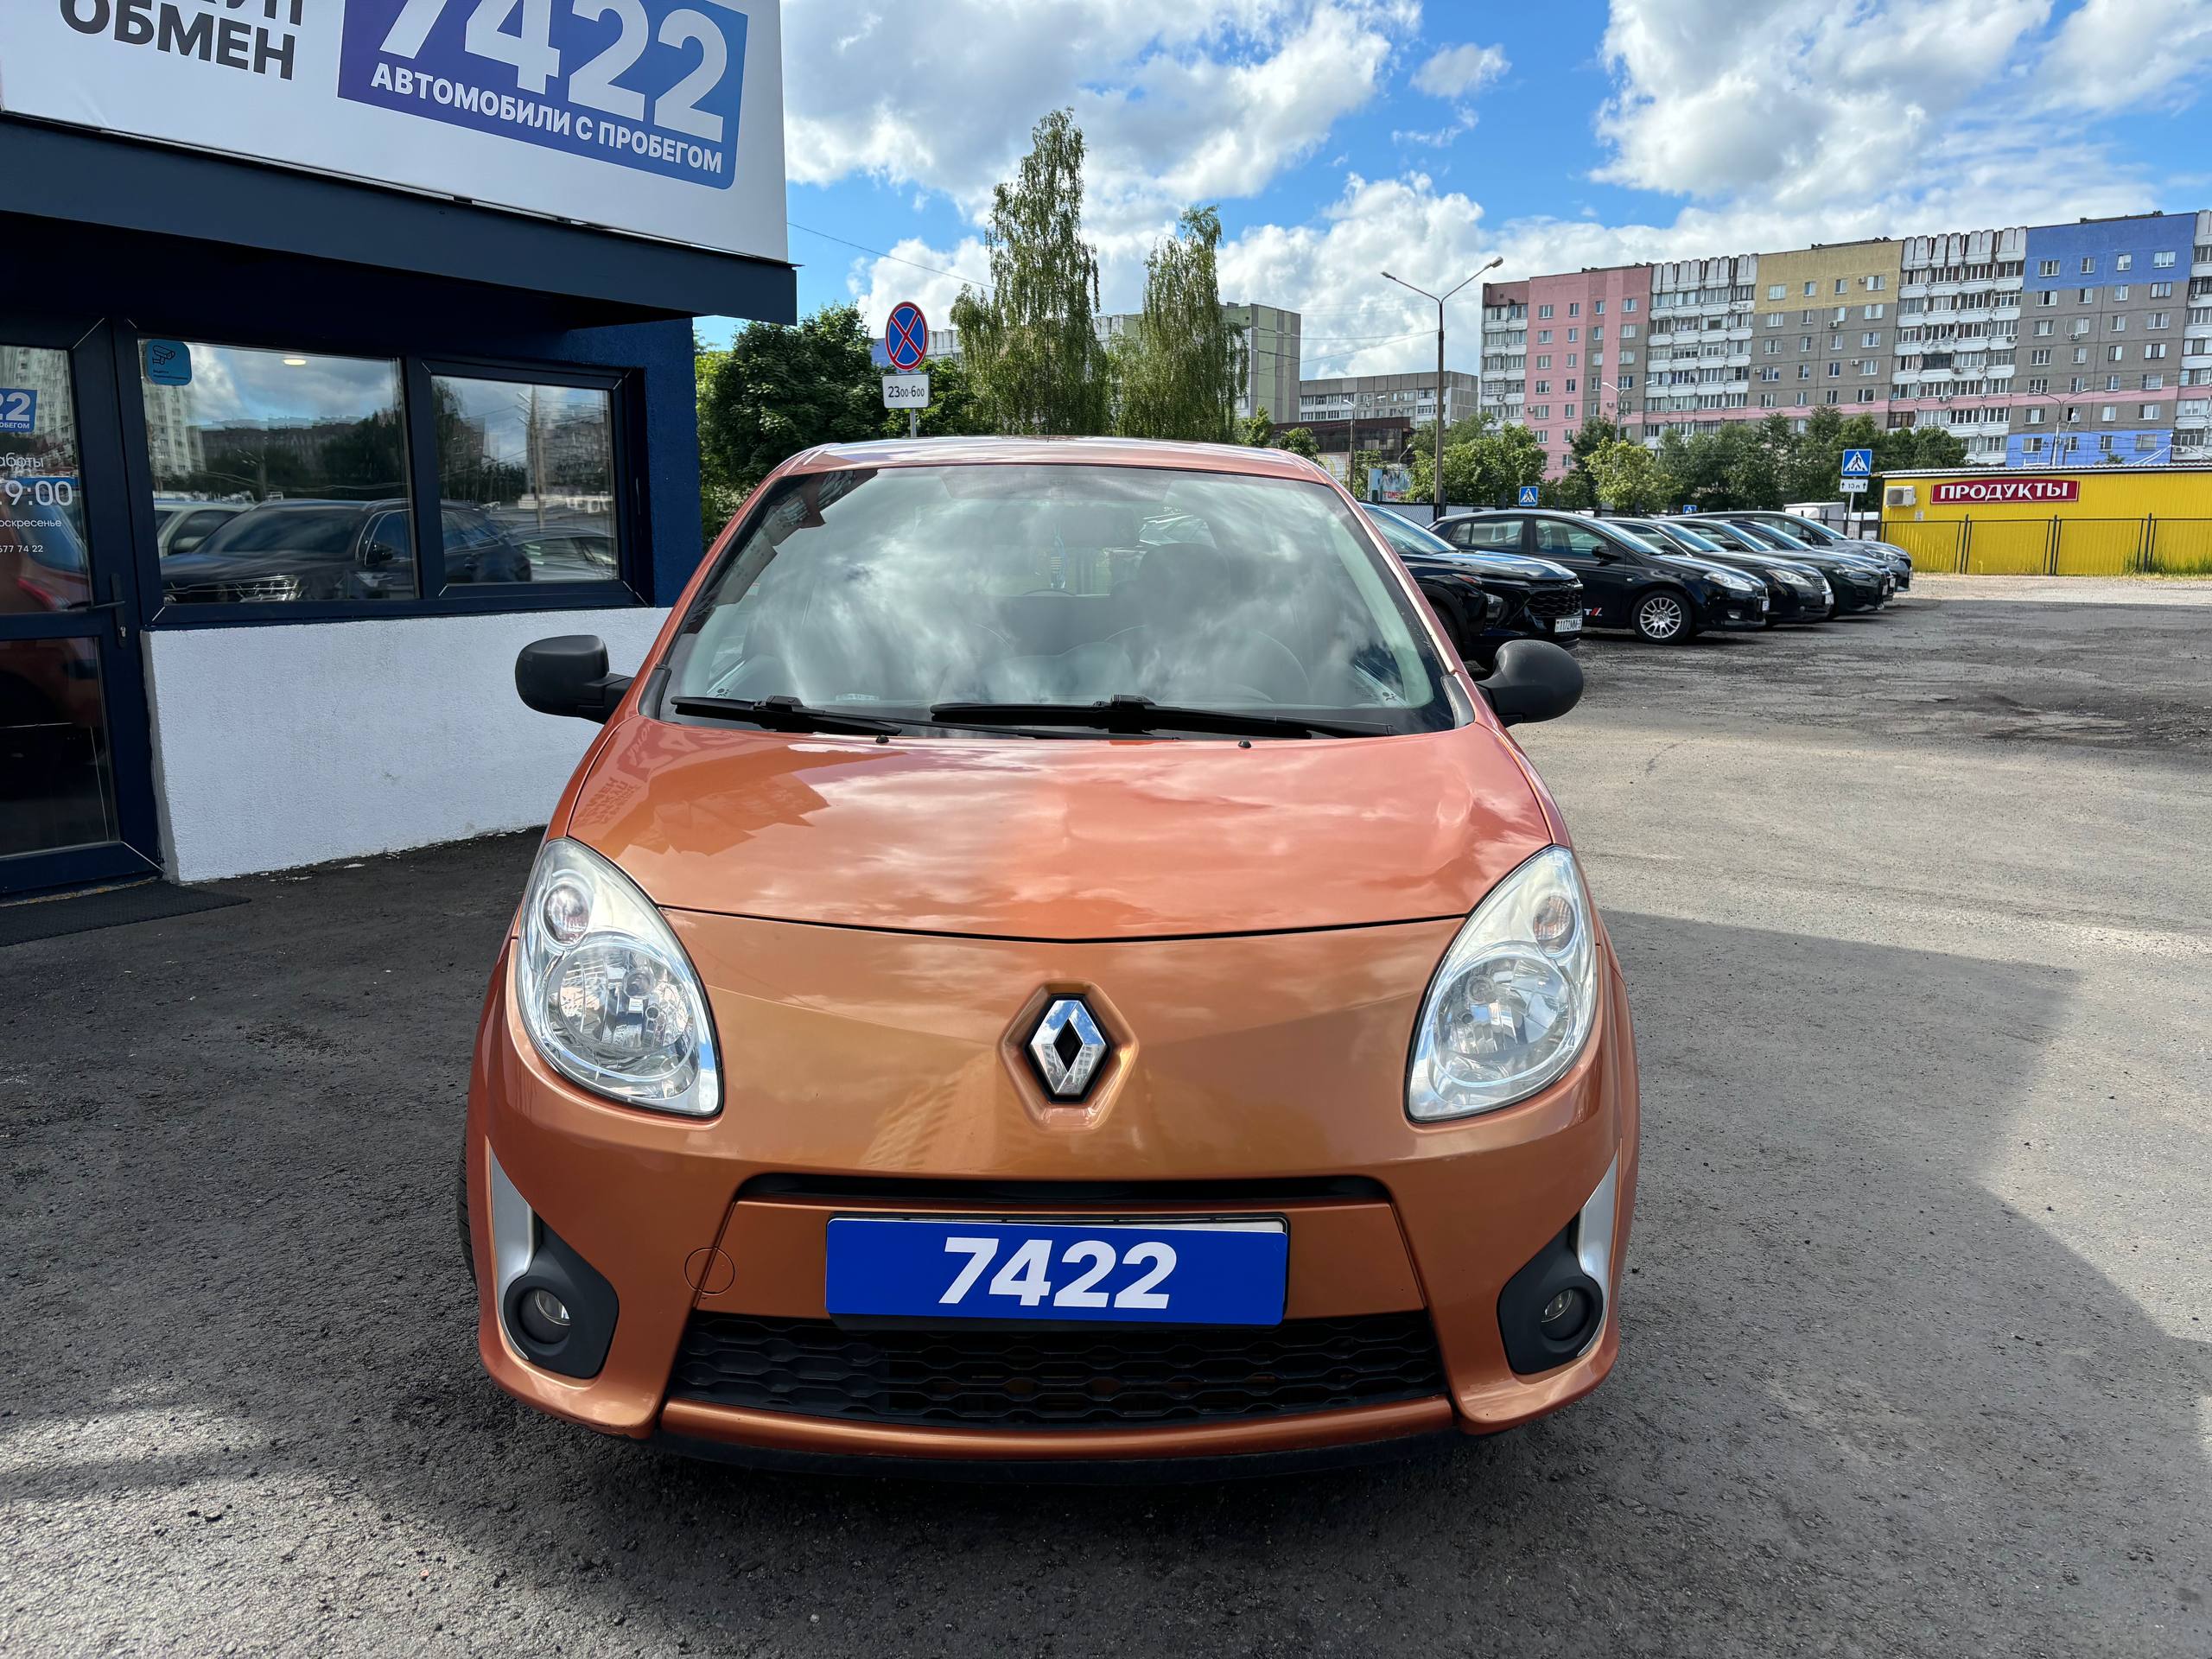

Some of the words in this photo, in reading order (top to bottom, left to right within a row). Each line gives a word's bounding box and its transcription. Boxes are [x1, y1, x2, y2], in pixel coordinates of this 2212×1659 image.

[59, 0, 296, 80] ОБМЕН
[371, 62, 571, 136] АВТОМОБИЛИ
[575, 115, 594, 139] С
[598, 122, 722, 174] ПРОБЕГОМ
[1940, 482, 2069, 501] ПРОДУКТЫ
[32, 544, 44, 553] 22
[938, 1236, 1177, 1309] 7422
